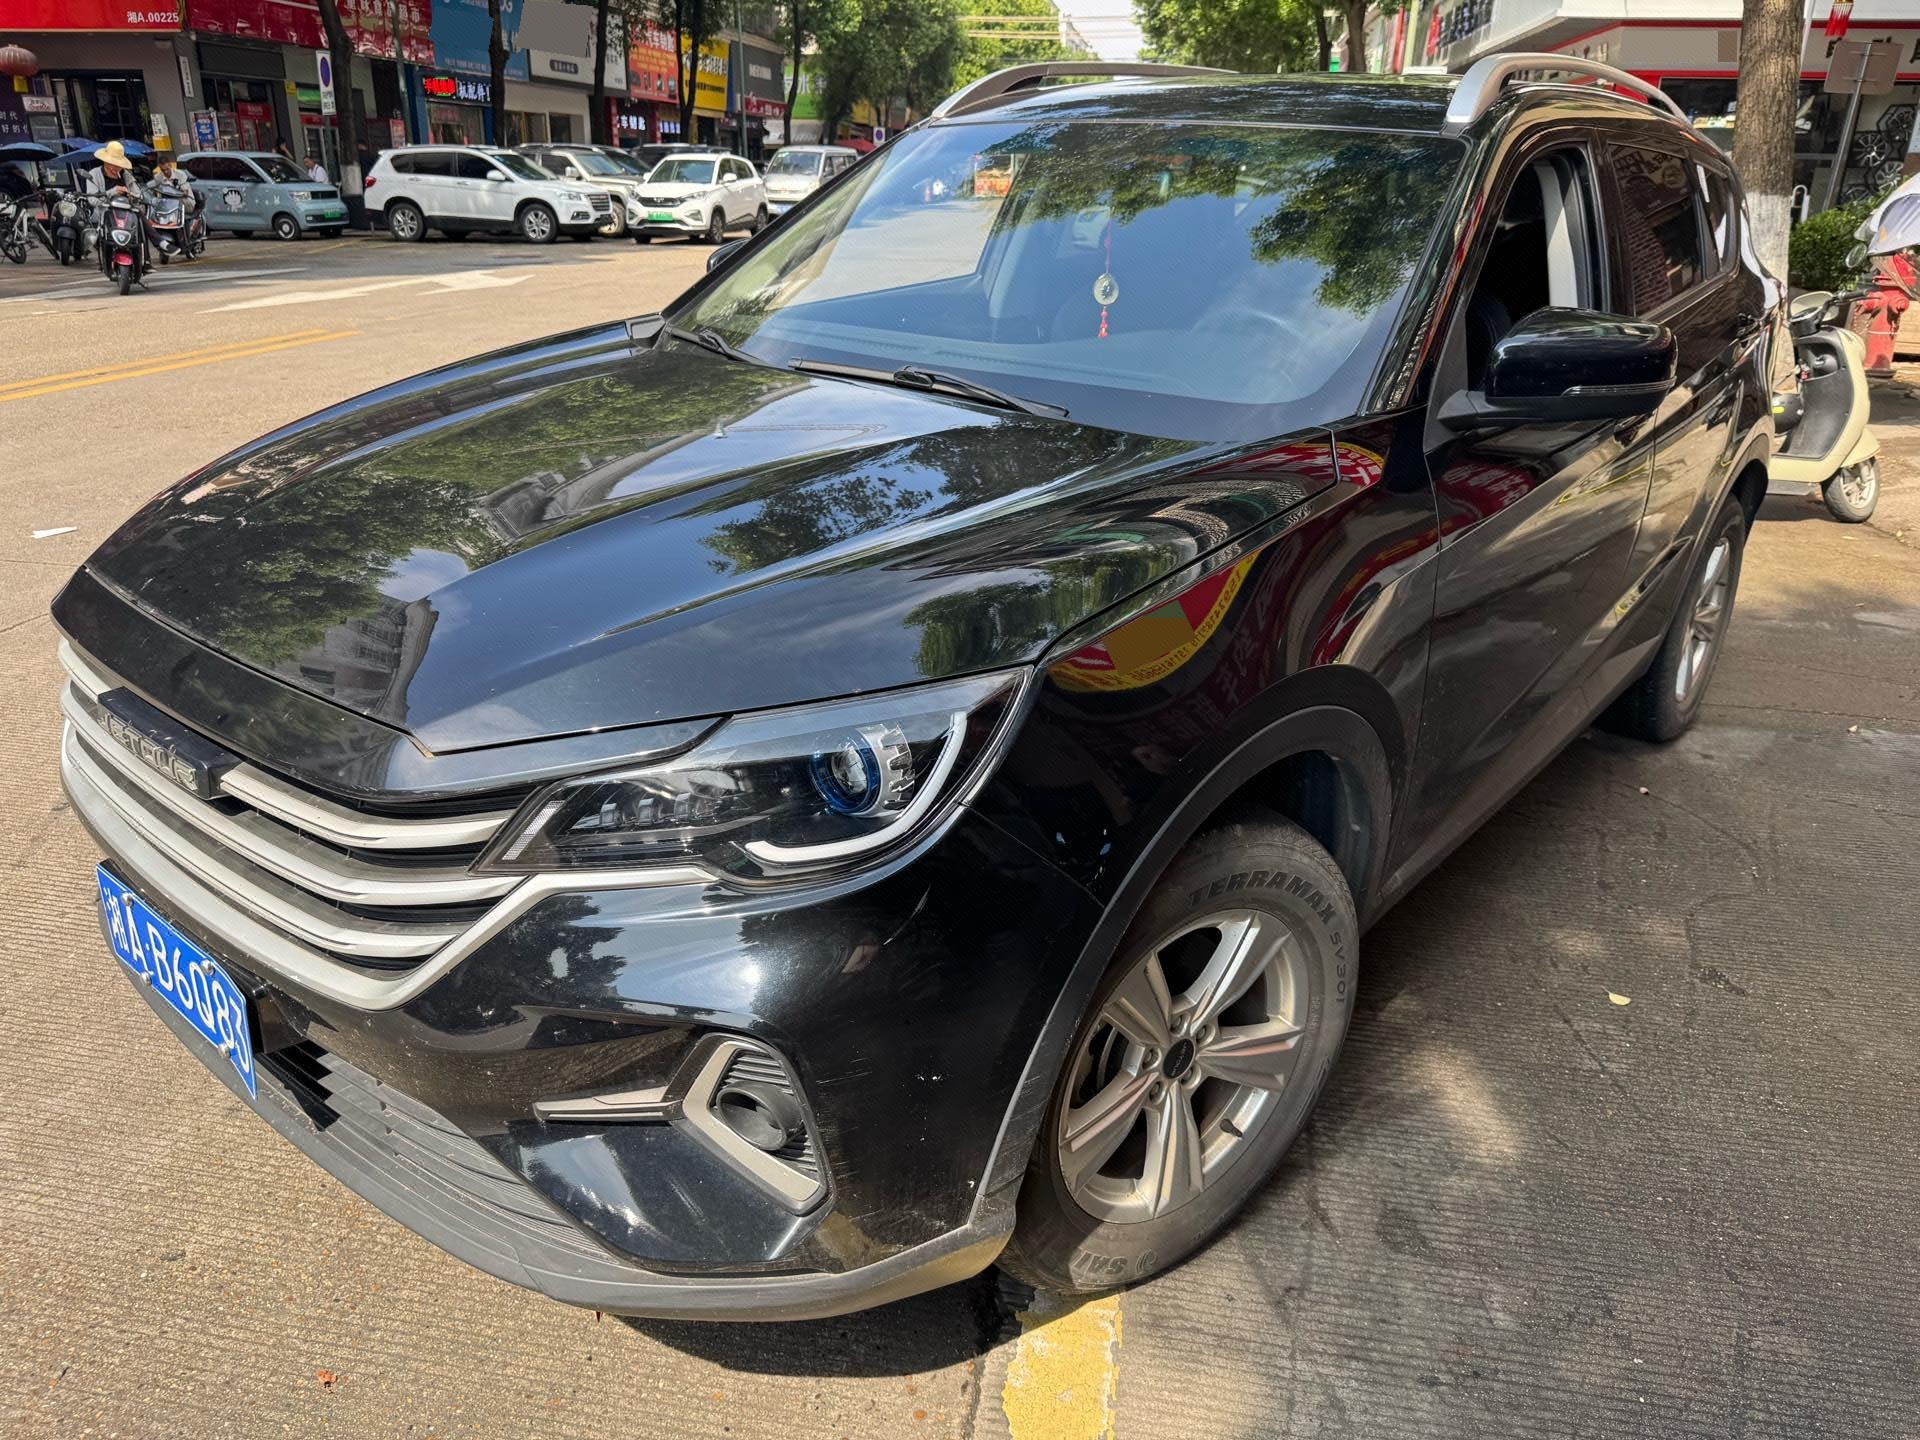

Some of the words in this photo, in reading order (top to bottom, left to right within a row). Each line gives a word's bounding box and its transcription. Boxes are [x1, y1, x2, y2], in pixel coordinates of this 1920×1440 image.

[127, 10, 180, 24] 湘A.00225
[97, 713, 198, 791] JETOUR
[1189, 870, 1336, 925] TERRAMAX
[1329, 930, 1347, 1003] SV301
